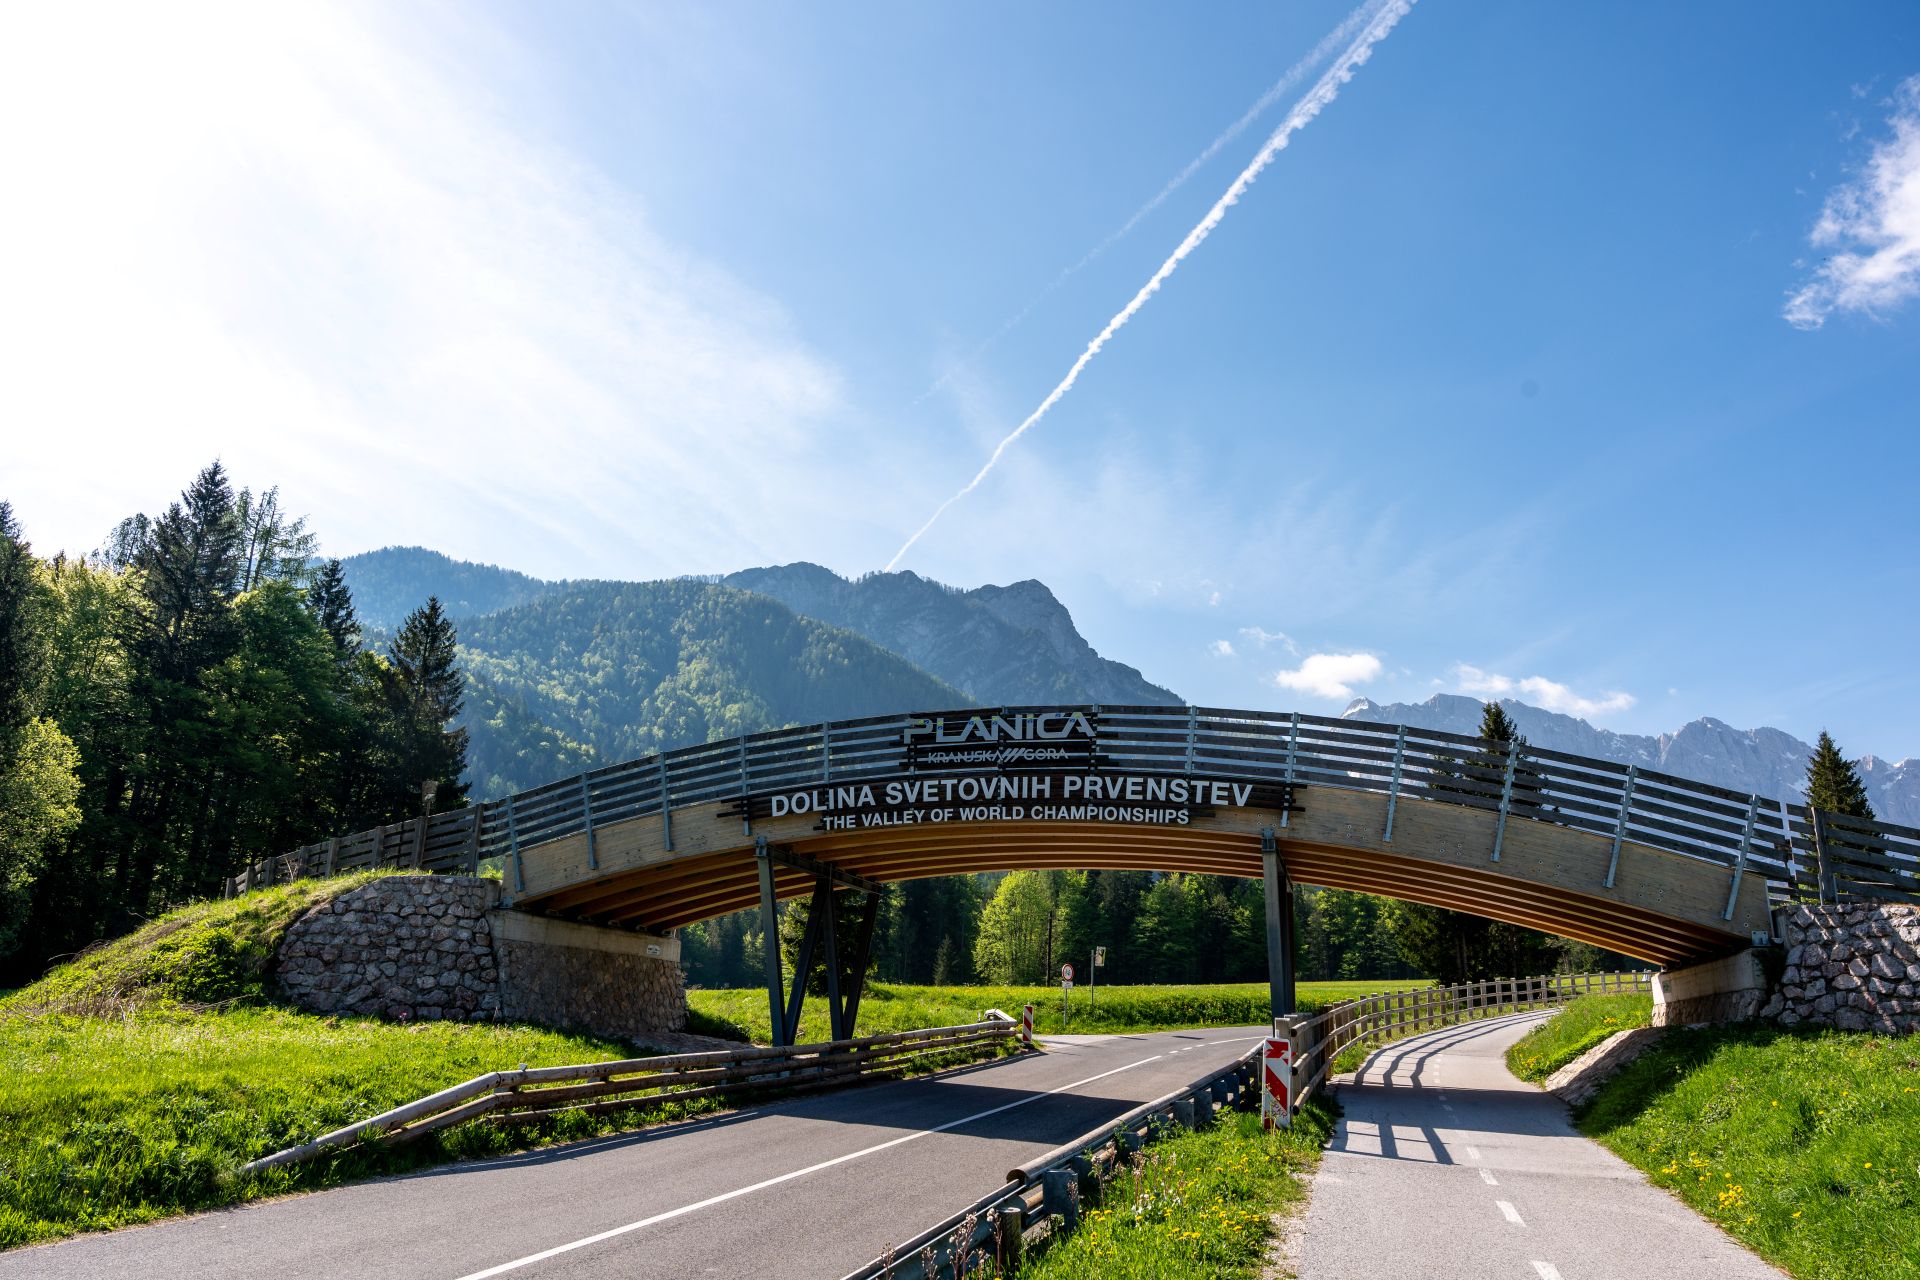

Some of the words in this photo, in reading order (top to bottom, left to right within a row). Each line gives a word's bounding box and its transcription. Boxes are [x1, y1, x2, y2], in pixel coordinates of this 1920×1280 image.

[904, 712, 1096, 744] PLANICA
[1024, 748, 1069, 760] GORA
[771, 785, 876, 817] DOLINA
[885, 776, 1050, 805] SVETOVNIH
[1064, 776, 1253, 807] PRVENSTEV
[823, 815, 856, 830] THE
[861, 808, 925, 826] VALLEY
[930, 808, 953, 822] OF
[959, 806, 1024, 820] WORLD
[1031, 805, 1189, 824] CHAMPIONSHIPS
